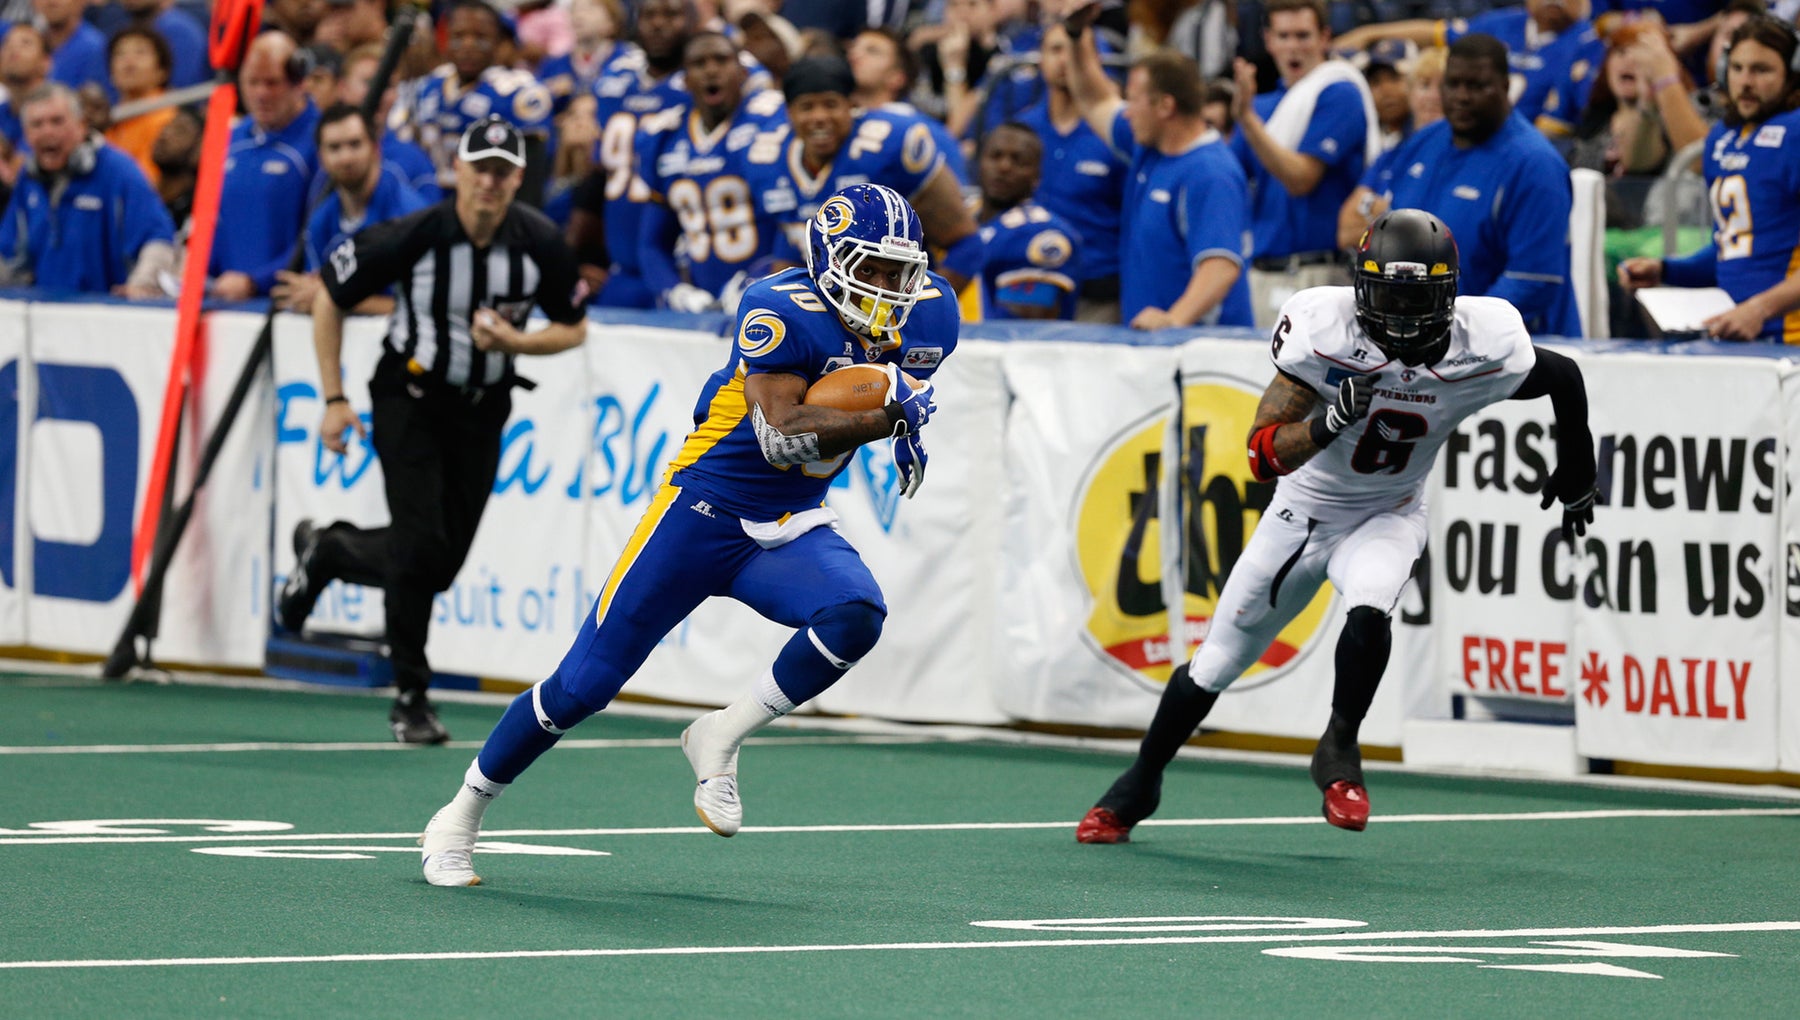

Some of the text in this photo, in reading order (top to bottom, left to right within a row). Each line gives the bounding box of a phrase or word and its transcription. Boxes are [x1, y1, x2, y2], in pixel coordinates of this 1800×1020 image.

[1351, 407, 1429, 475] 6
[1595, 434, 1792, 514] news
[517, 565, 561, 633] of
[1541, 527, 1658, 614] can
[1462, 635, 1753, 721] FREE DAILY
